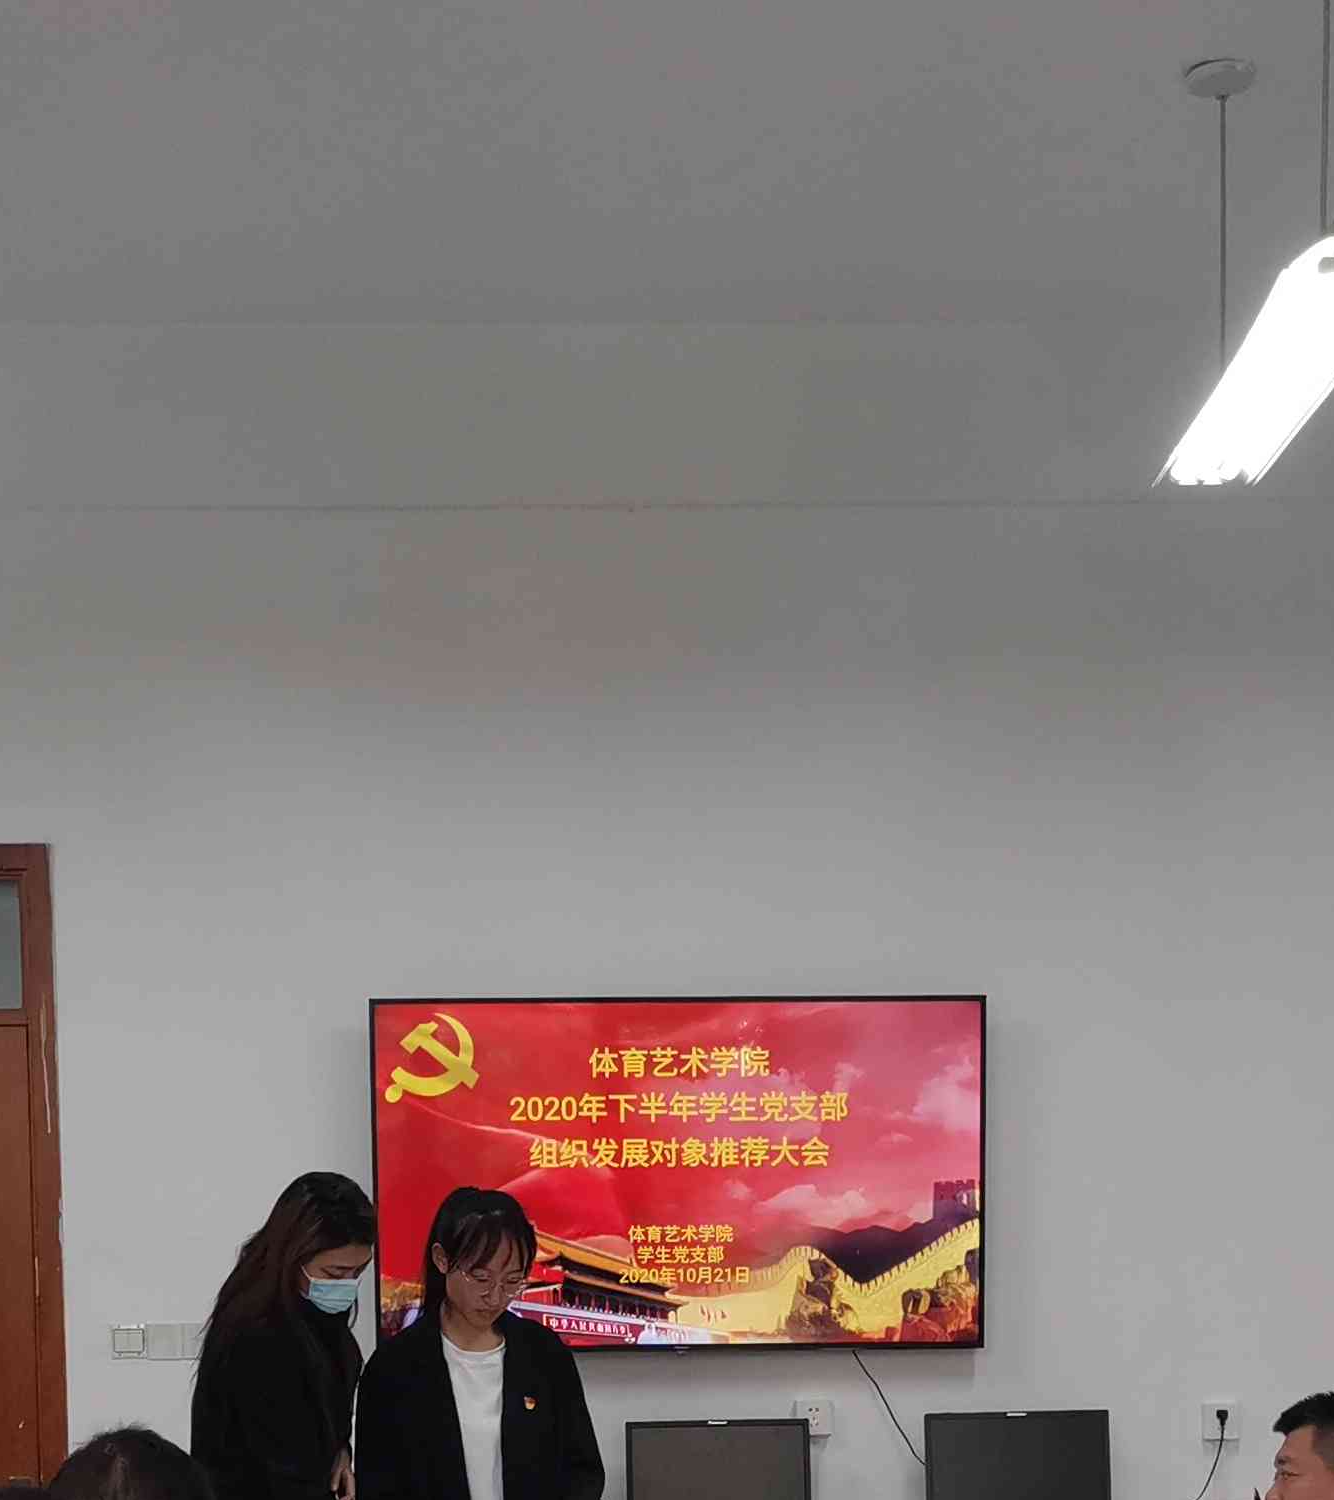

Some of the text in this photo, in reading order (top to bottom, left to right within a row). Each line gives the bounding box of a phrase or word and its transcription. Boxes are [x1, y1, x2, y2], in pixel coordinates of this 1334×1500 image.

[588, 1046, 771, 1079] 体育艺术学院
[509, 1091, 849, 1124] 2020年下半年学生党支部
[529, 1135, 830, 1168] 组织发展对象推荐大会
[628, 1224, 734, 1243] 体育艺术学院
[637, 1245, 724, 1264] 学生党支部
[618, 1266, 750, 1284] 2020年10月21日
